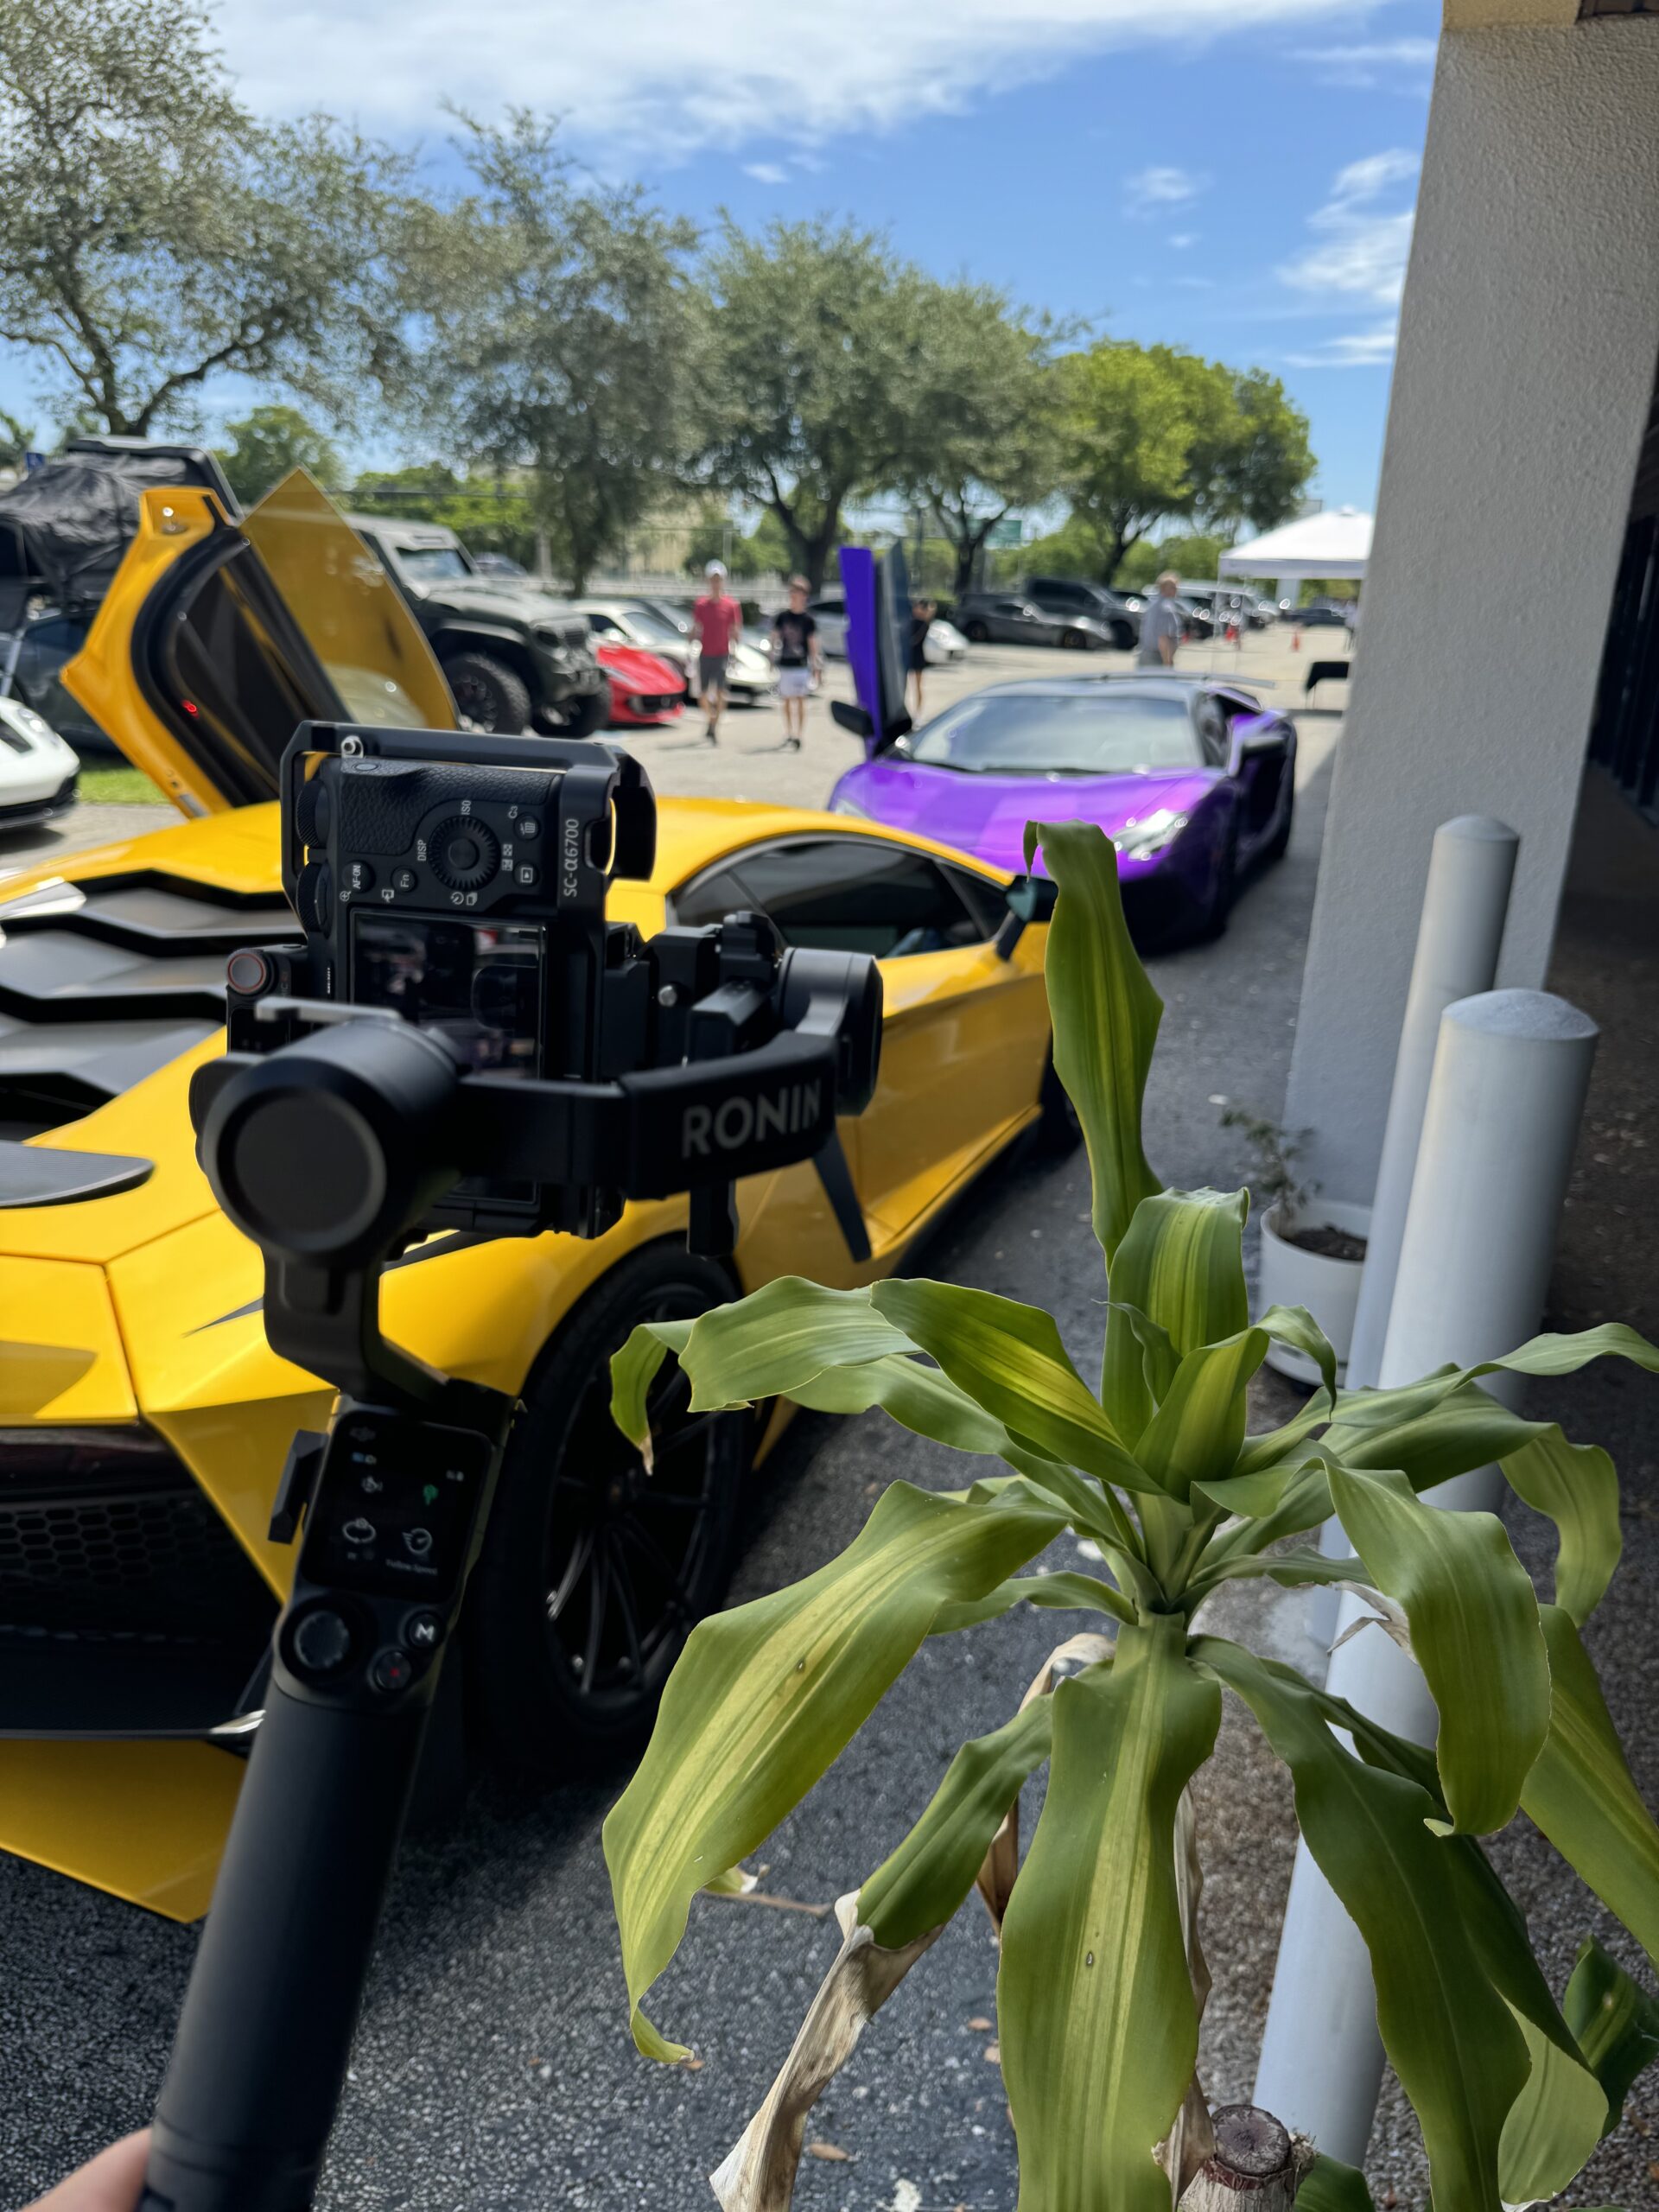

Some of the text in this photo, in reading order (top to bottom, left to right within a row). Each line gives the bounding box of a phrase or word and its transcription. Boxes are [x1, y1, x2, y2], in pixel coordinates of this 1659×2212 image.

[461, 800, 471, 815] ISO
[508, 805, 518, 819] C3
[417, 840, 427, 861] DISP
[353, 865, 361, 889] AF-ON
[401, 874, 410, 887] Fn
[682, 1078, 821, 1159] RONIN
[416, 1623, 435, 1641] M
